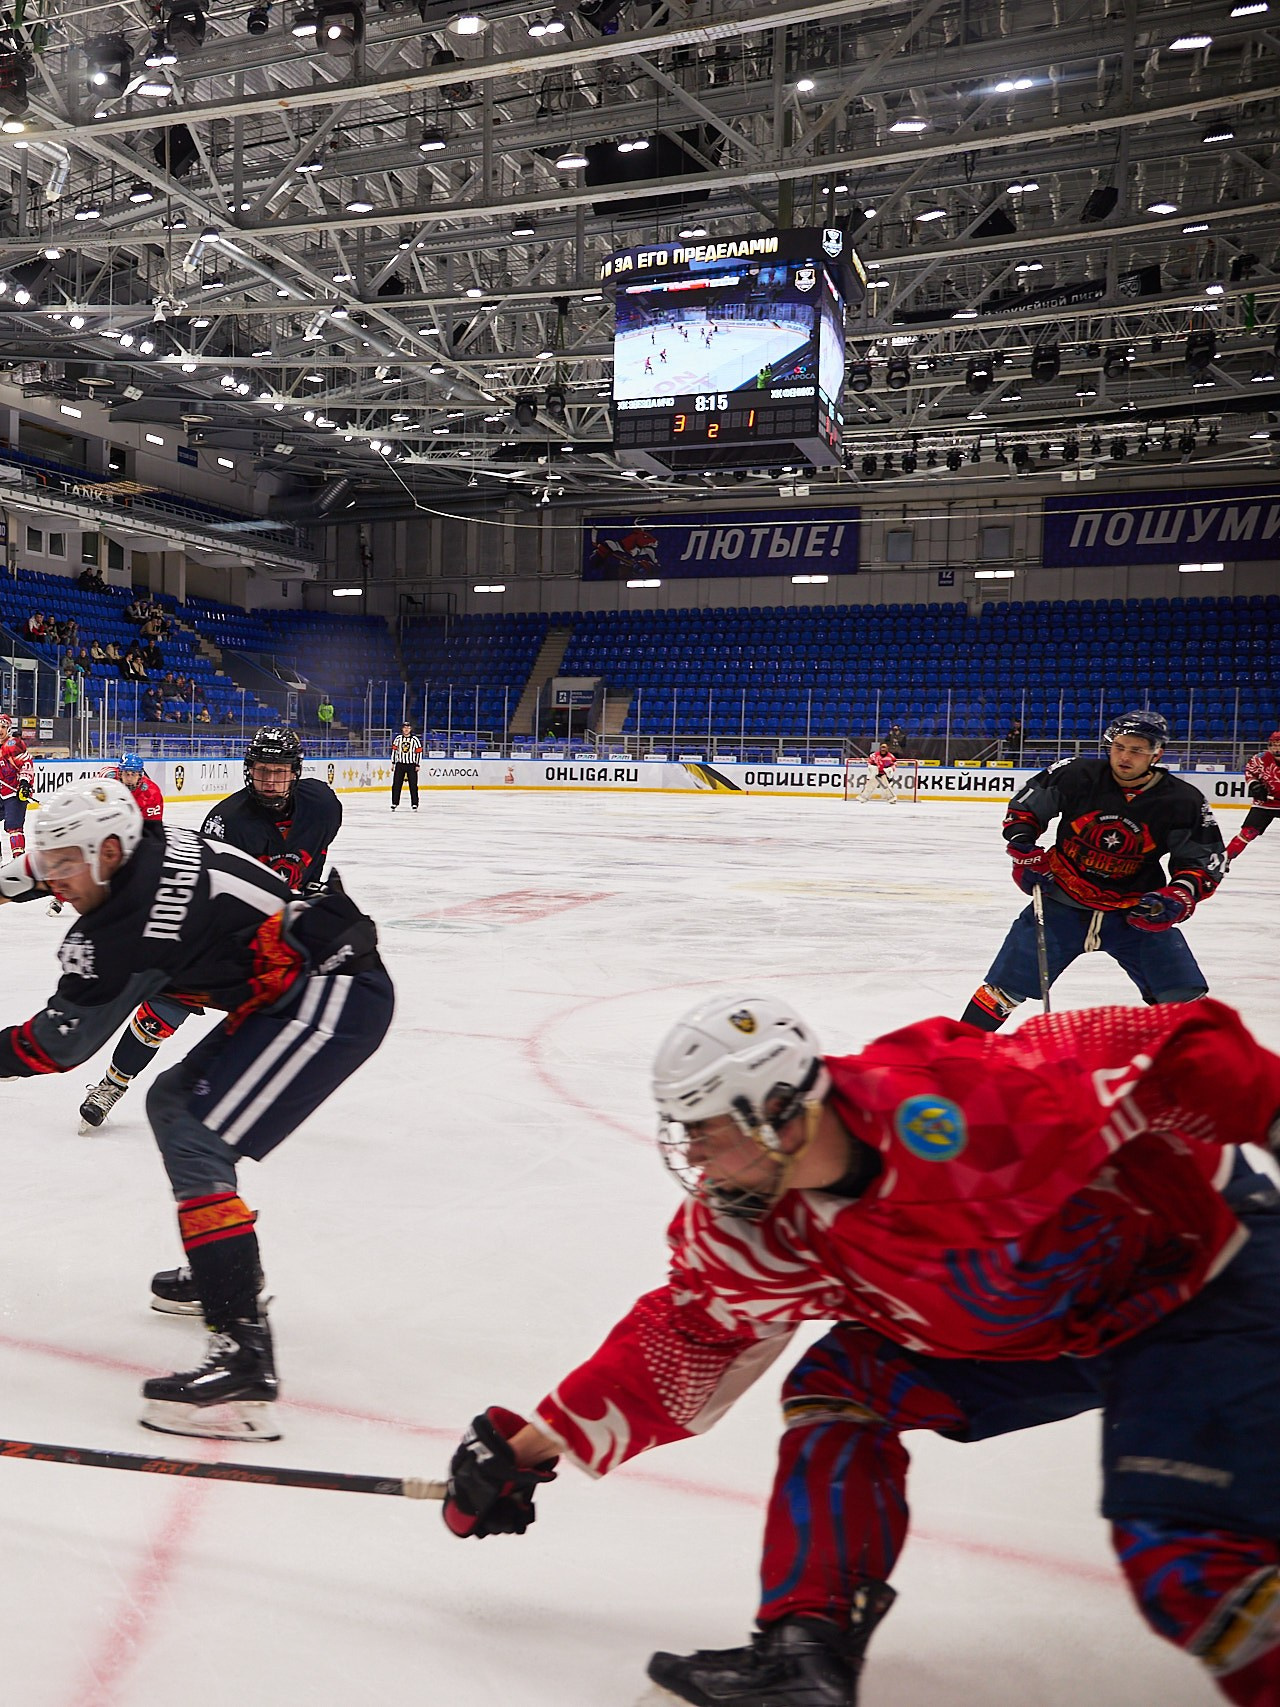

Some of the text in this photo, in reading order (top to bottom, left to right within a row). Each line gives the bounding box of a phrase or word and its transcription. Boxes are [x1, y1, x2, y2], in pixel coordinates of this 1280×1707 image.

[614, 256, 634, 273] ЗА
[637, 250, 667, 268] ЕГО
[673, 237, 779, 265] ПРЕДЕЛАМИ
[1071, 289, 1104, 304] ЛИГИ
[694, 394, 728, 412] 8:15
[673, 414, 687, 432] 3
[748, 409, 755, 427] 1
[707, 423, 719, 438] 2
[680, 526, 846, 562] ЛЮТЫЕ!
[200, 763, 229, 780] ЛИГА
[545, 766, 639, 783] OHLIGA.RU
[1215, 781, 1252, 798] OH
[146, 805, 161, 817] 92
